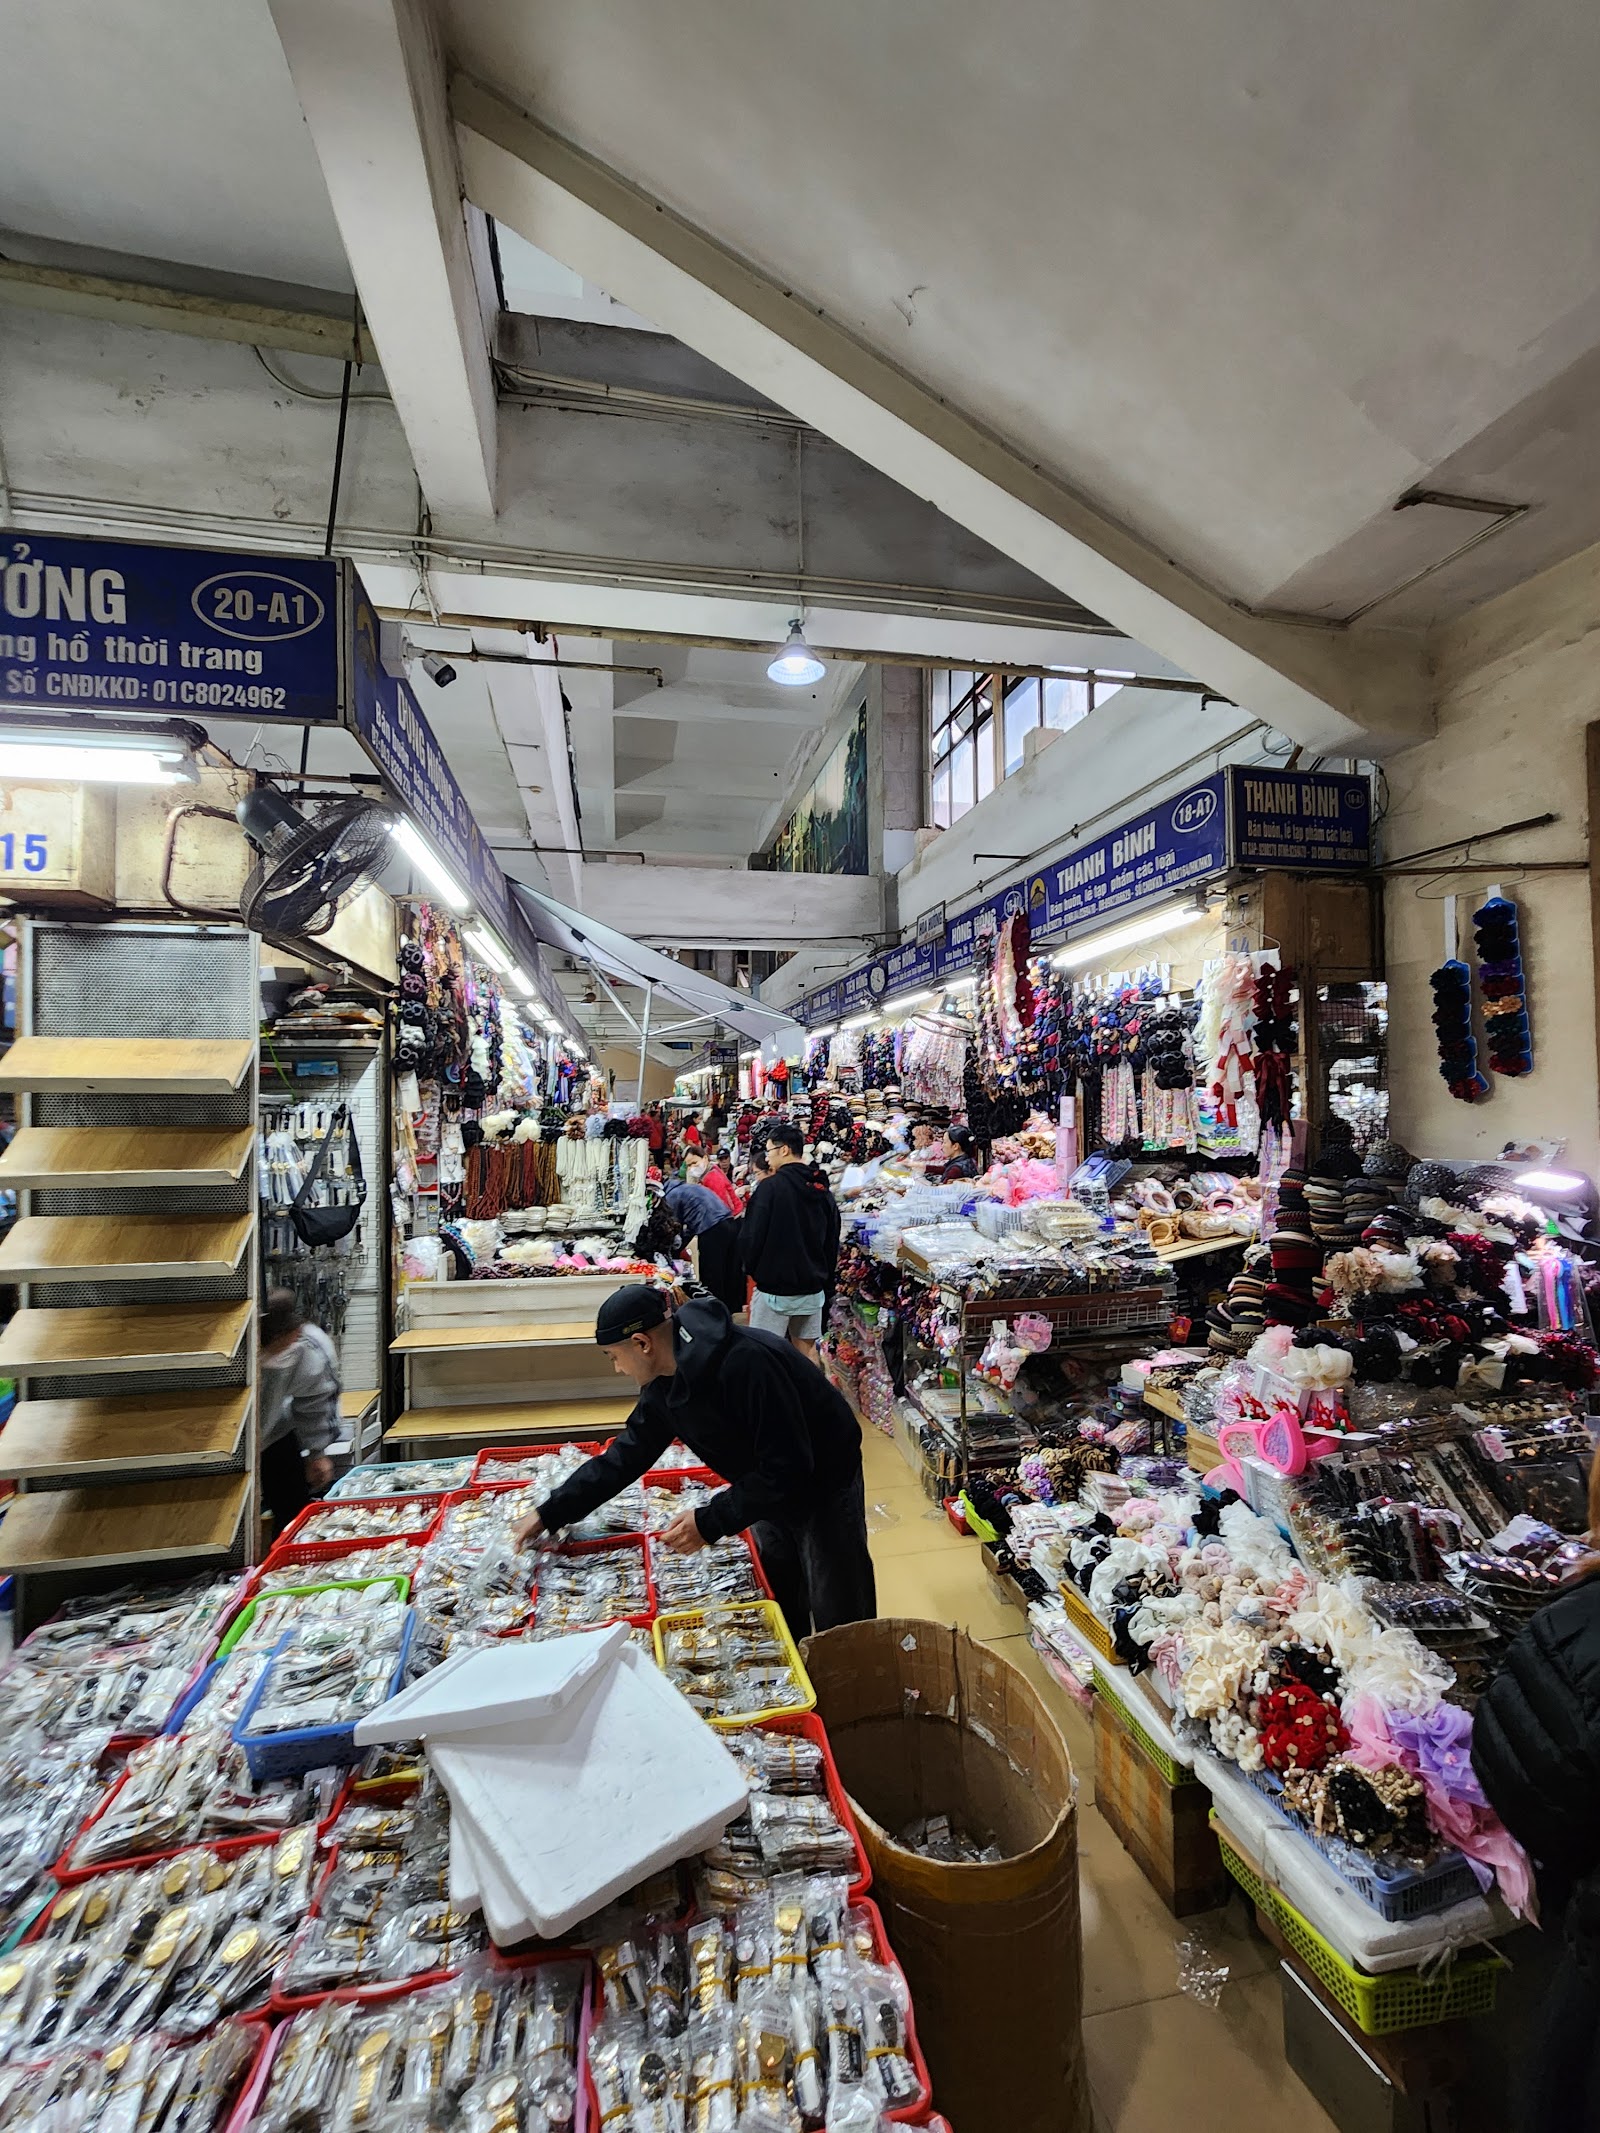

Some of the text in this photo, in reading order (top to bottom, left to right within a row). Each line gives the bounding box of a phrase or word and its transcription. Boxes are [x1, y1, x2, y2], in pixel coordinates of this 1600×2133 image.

[0, 542, 127, 625] ỞNG
[213, 587, 305, 625] 20-A1
[48, 630, 90, 663] hồ
[104, 635, 168, 667] thời
[179, 640, 263, 675] trang
[6, 667, 39, 695] Số
[1178, 795, 1211, 826] 18-A1
[1244, 780, 1297, 815] THANH
[1301, 777, 1340, 818] BÌNH
[1247, 819, 1262, 837] Bán
[1057, 821, 1156, 895] THANH BÌNH
[1050, 901, 1063, 917] Bán
[1136, 860, 1154, 879] các
